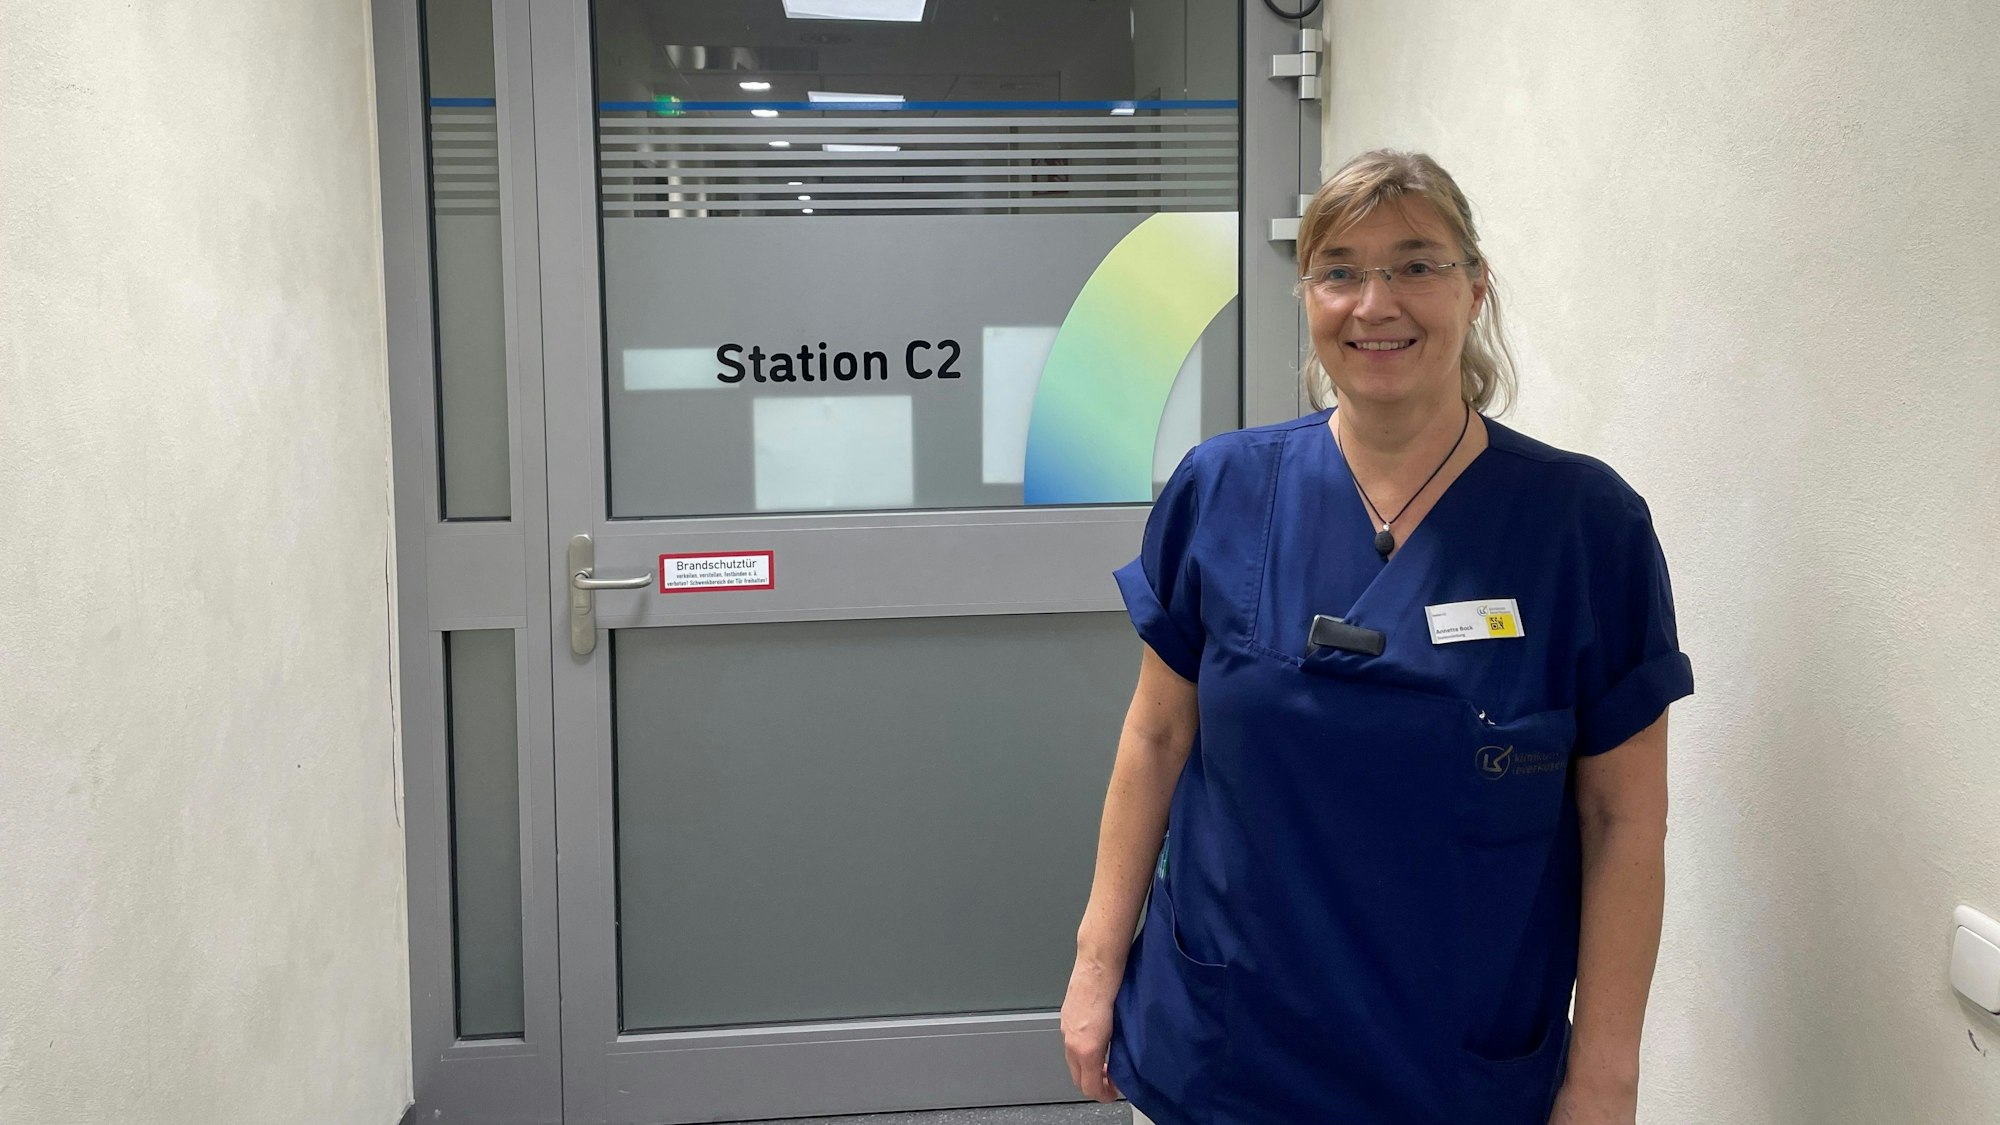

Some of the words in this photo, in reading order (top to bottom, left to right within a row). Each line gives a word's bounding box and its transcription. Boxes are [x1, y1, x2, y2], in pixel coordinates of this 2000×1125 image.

[716, 342, 888, 383] Station
[905, 339, 961, 379] C2
[676, 558, 757, 571] Brandschutztür
[1436, 626, 1459, 635] Annette
